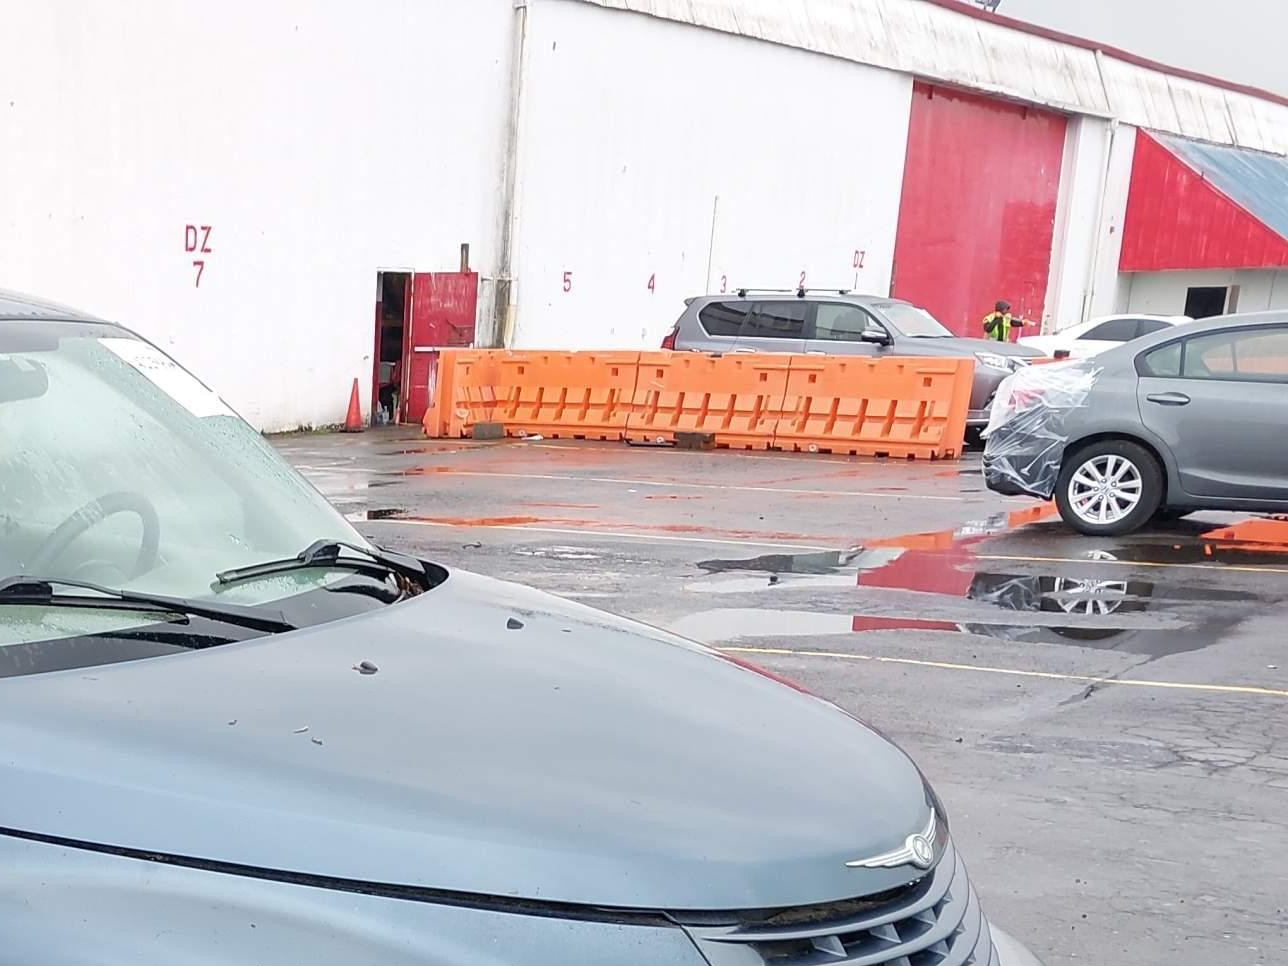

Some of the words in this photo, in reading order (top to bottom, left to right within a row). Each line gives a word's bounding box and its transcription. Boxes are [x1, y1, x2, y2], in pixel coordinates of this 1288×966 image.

[184, 223, 213, 254] DZ
[192, 260, 205, 289] 7
[562, 271, 572, 293] 5
[647, 273, 656, 294] 4
[719, 274, 727, 293] 3
[798, 270, 806, 288] 2
